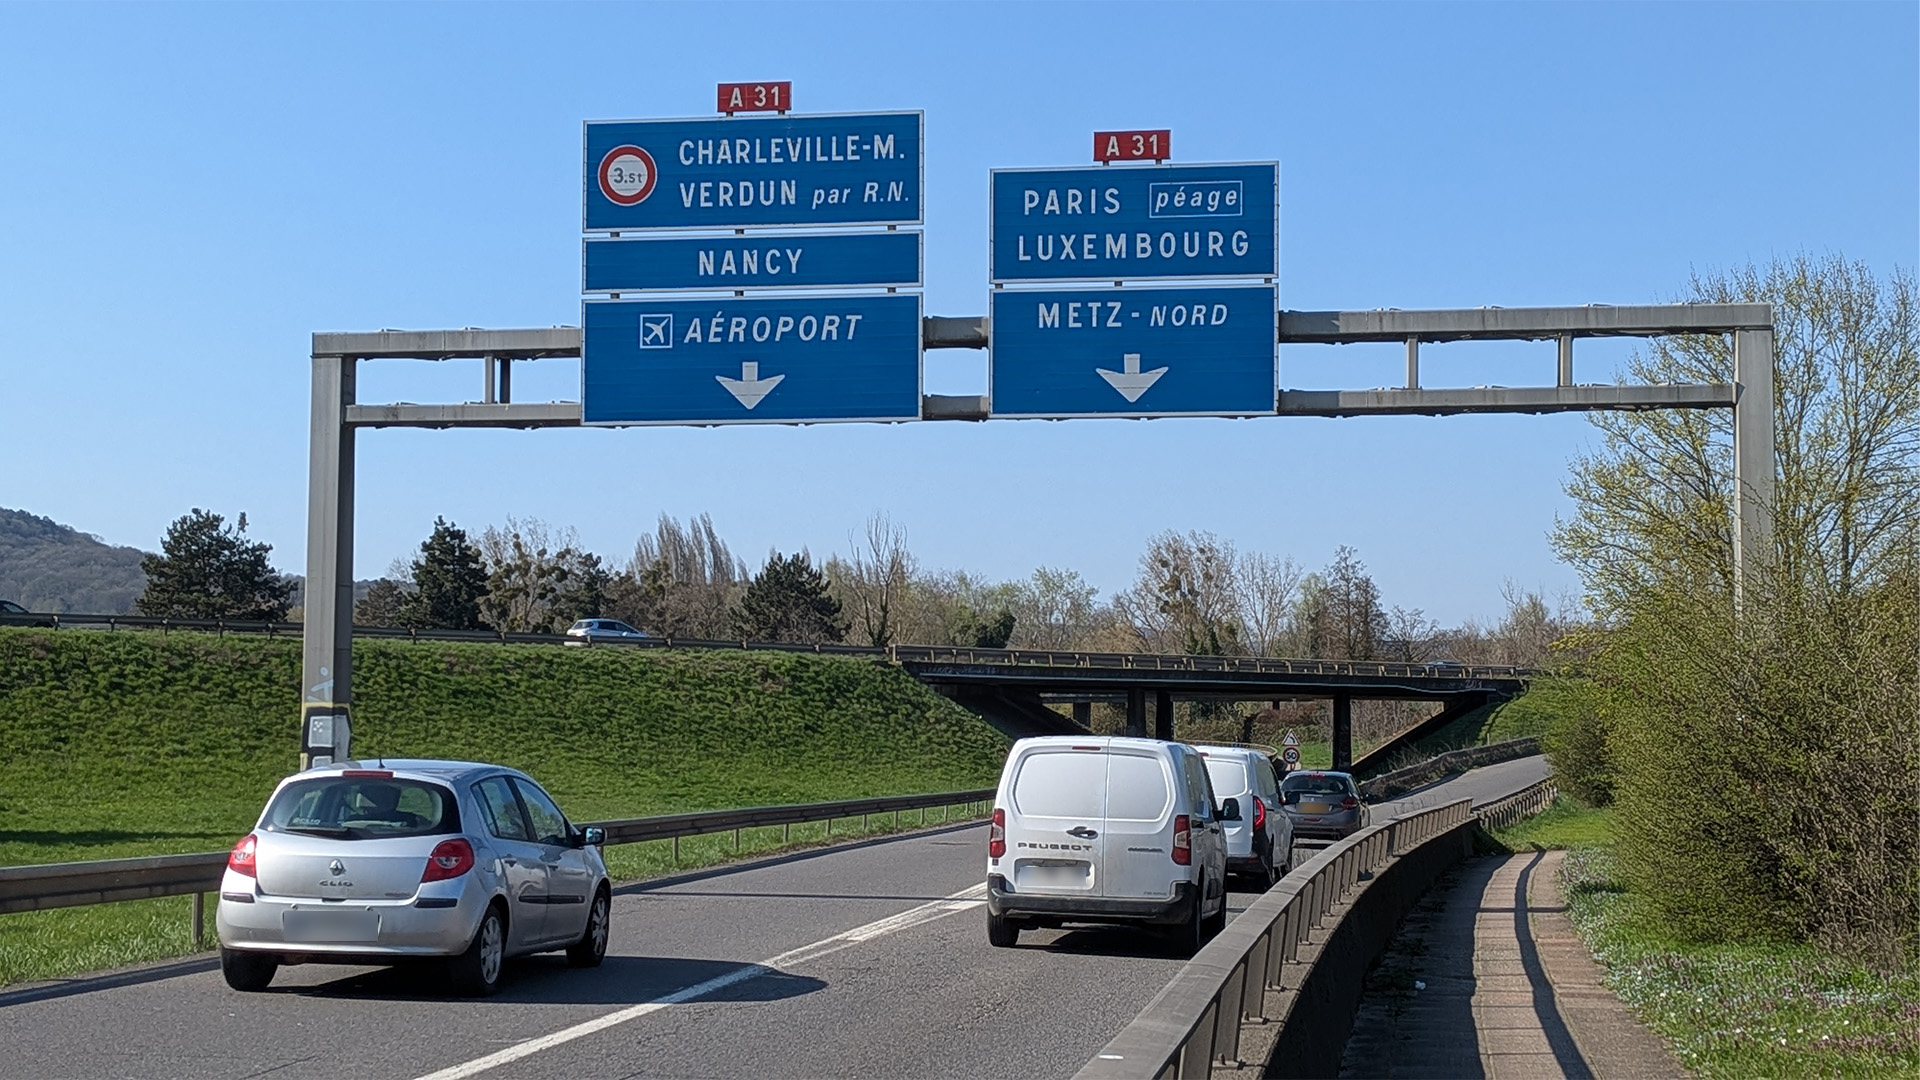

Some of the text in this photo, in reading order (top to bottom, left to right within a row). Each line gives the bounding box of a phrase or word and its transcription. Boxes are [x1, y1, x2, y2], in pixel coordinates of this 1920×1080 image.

[729, 85, 780, 108] A 31
[678, 134, 906, 166] CHARLEVILLE-M.
[1106, 134, 1159, 157] A 31
[679, 179, 909, 210] VERDUN par R.N.
[1024, 186, 1238, 215] PARIS péage
[1018, 230, 1249, 261] LUXEMBOURG
[698, 248, 803, 276] NANCY
[683, 311, 863, 344] AÉROPORT
[1286, 751, 1297, 760] 50
[1017, 842, 1093, 852] PEUGEOT
[319, 879, 354, 888] CLIO
